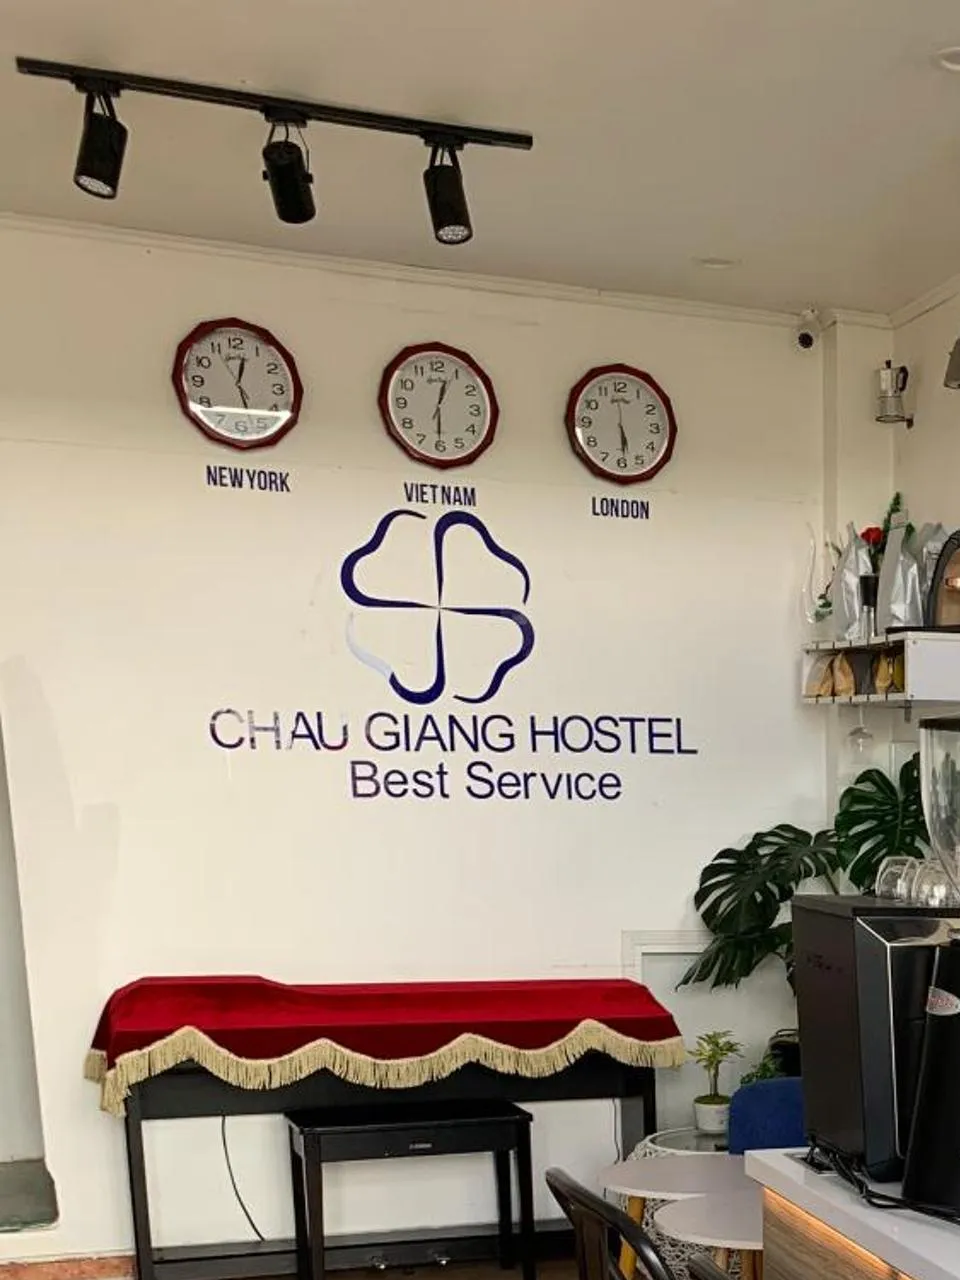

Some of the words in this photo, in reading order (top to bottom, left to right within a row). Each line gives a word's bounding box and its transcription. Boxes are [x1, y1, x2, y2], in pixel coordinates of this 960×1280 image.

[211, 342, 221, 355] 11
[228, 336, 244, 350] 12
[196, 356, 211, 369] 10
[266, 362, 279, 375] 2
[430, 361, 445, 372] 12
[414, 364, 424, 377] 11
[191, 375, 204, 388] 9
[400, 378, 414, 391] 10
[614, 381, 627, 393] 12
[272, 383, 285, 396] 3
[464, 384, 477, 396] 2
[598, 386, 608, 397] 11
[395, 397, 407, 409] 9
[469, 405, 481, 417] 3
[644, 404, 656, 415] 2
[234, 420, 248, 432] 6
[402, 417, 413, 429] 8
[581, 416, 592, 428] 9
[465, 424, 477, 435] 4
[649, 423, 660, 434] 3
[416, 433, 426, 444] 7
[454, 438, 465, 449] 5
[586, 436, 598, 447] 8
[434, 440, 446, 452] 6
[646, 441, 655, 452] 4
[600, 452, 609, 462] 7
[617, 457, 627, 468] 6
[634, 455, 644, 465] 5
[592, 496, 649, 519] LONDON
[209, 708, 348, 750] CHAU
[364, 711, 515, 752] GIANG
[530, 715, 698, 754] HOSTEL
[349, 760, 450, 799] Best
[466, 760, 622, 800] Service
